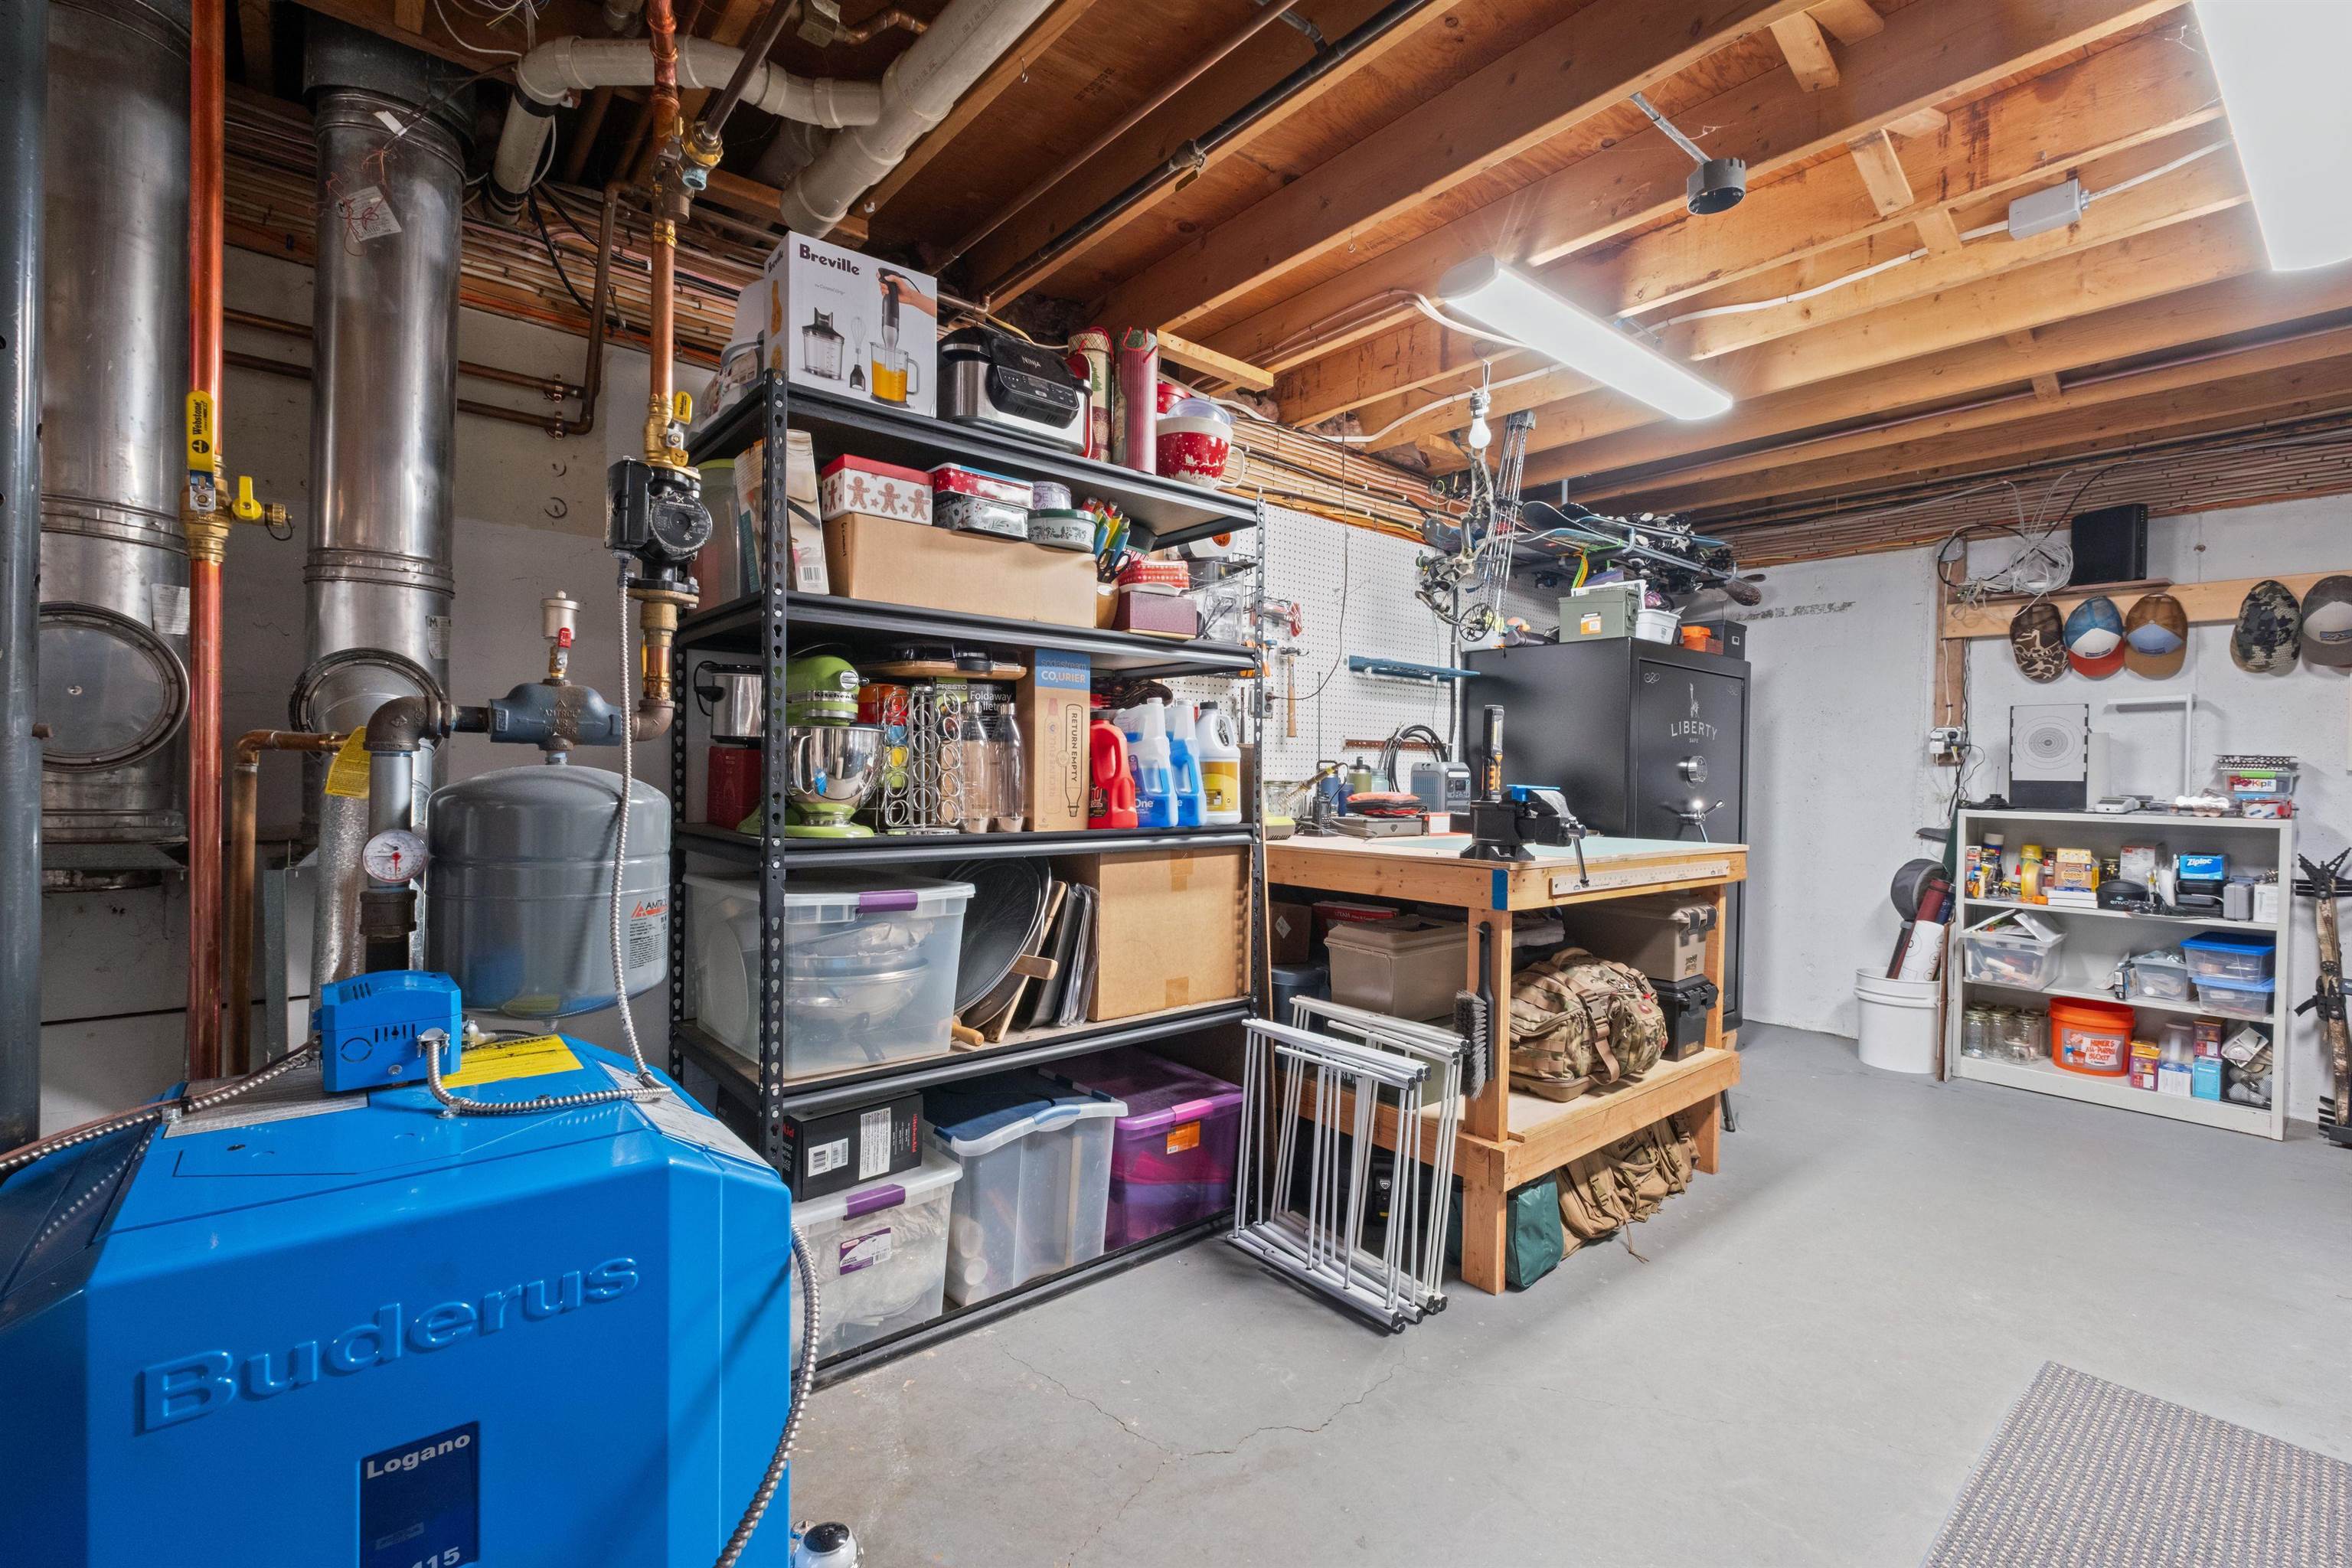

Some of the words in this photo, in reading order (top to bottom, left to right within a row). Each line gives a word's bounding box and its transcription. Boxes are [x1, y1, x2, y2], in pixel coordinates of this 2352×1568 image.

[799, 243, 860, 276] Breville
[1021, 355, 1041, 368] NINJA
[192, 400, 202, 435] Webstone
[815, 691, 858, 701] KitchenAi
[970, 690, 1011, 702] Foldaway
[1671, 720, 1717, 740] LIBERTY
[1135, 798, 1154, 808] One
[2187, 858, 2213, 867] Ziploc
[136, 1257, 639, 1433] Buderus
[367, 1434, 471, 1479] Logano
